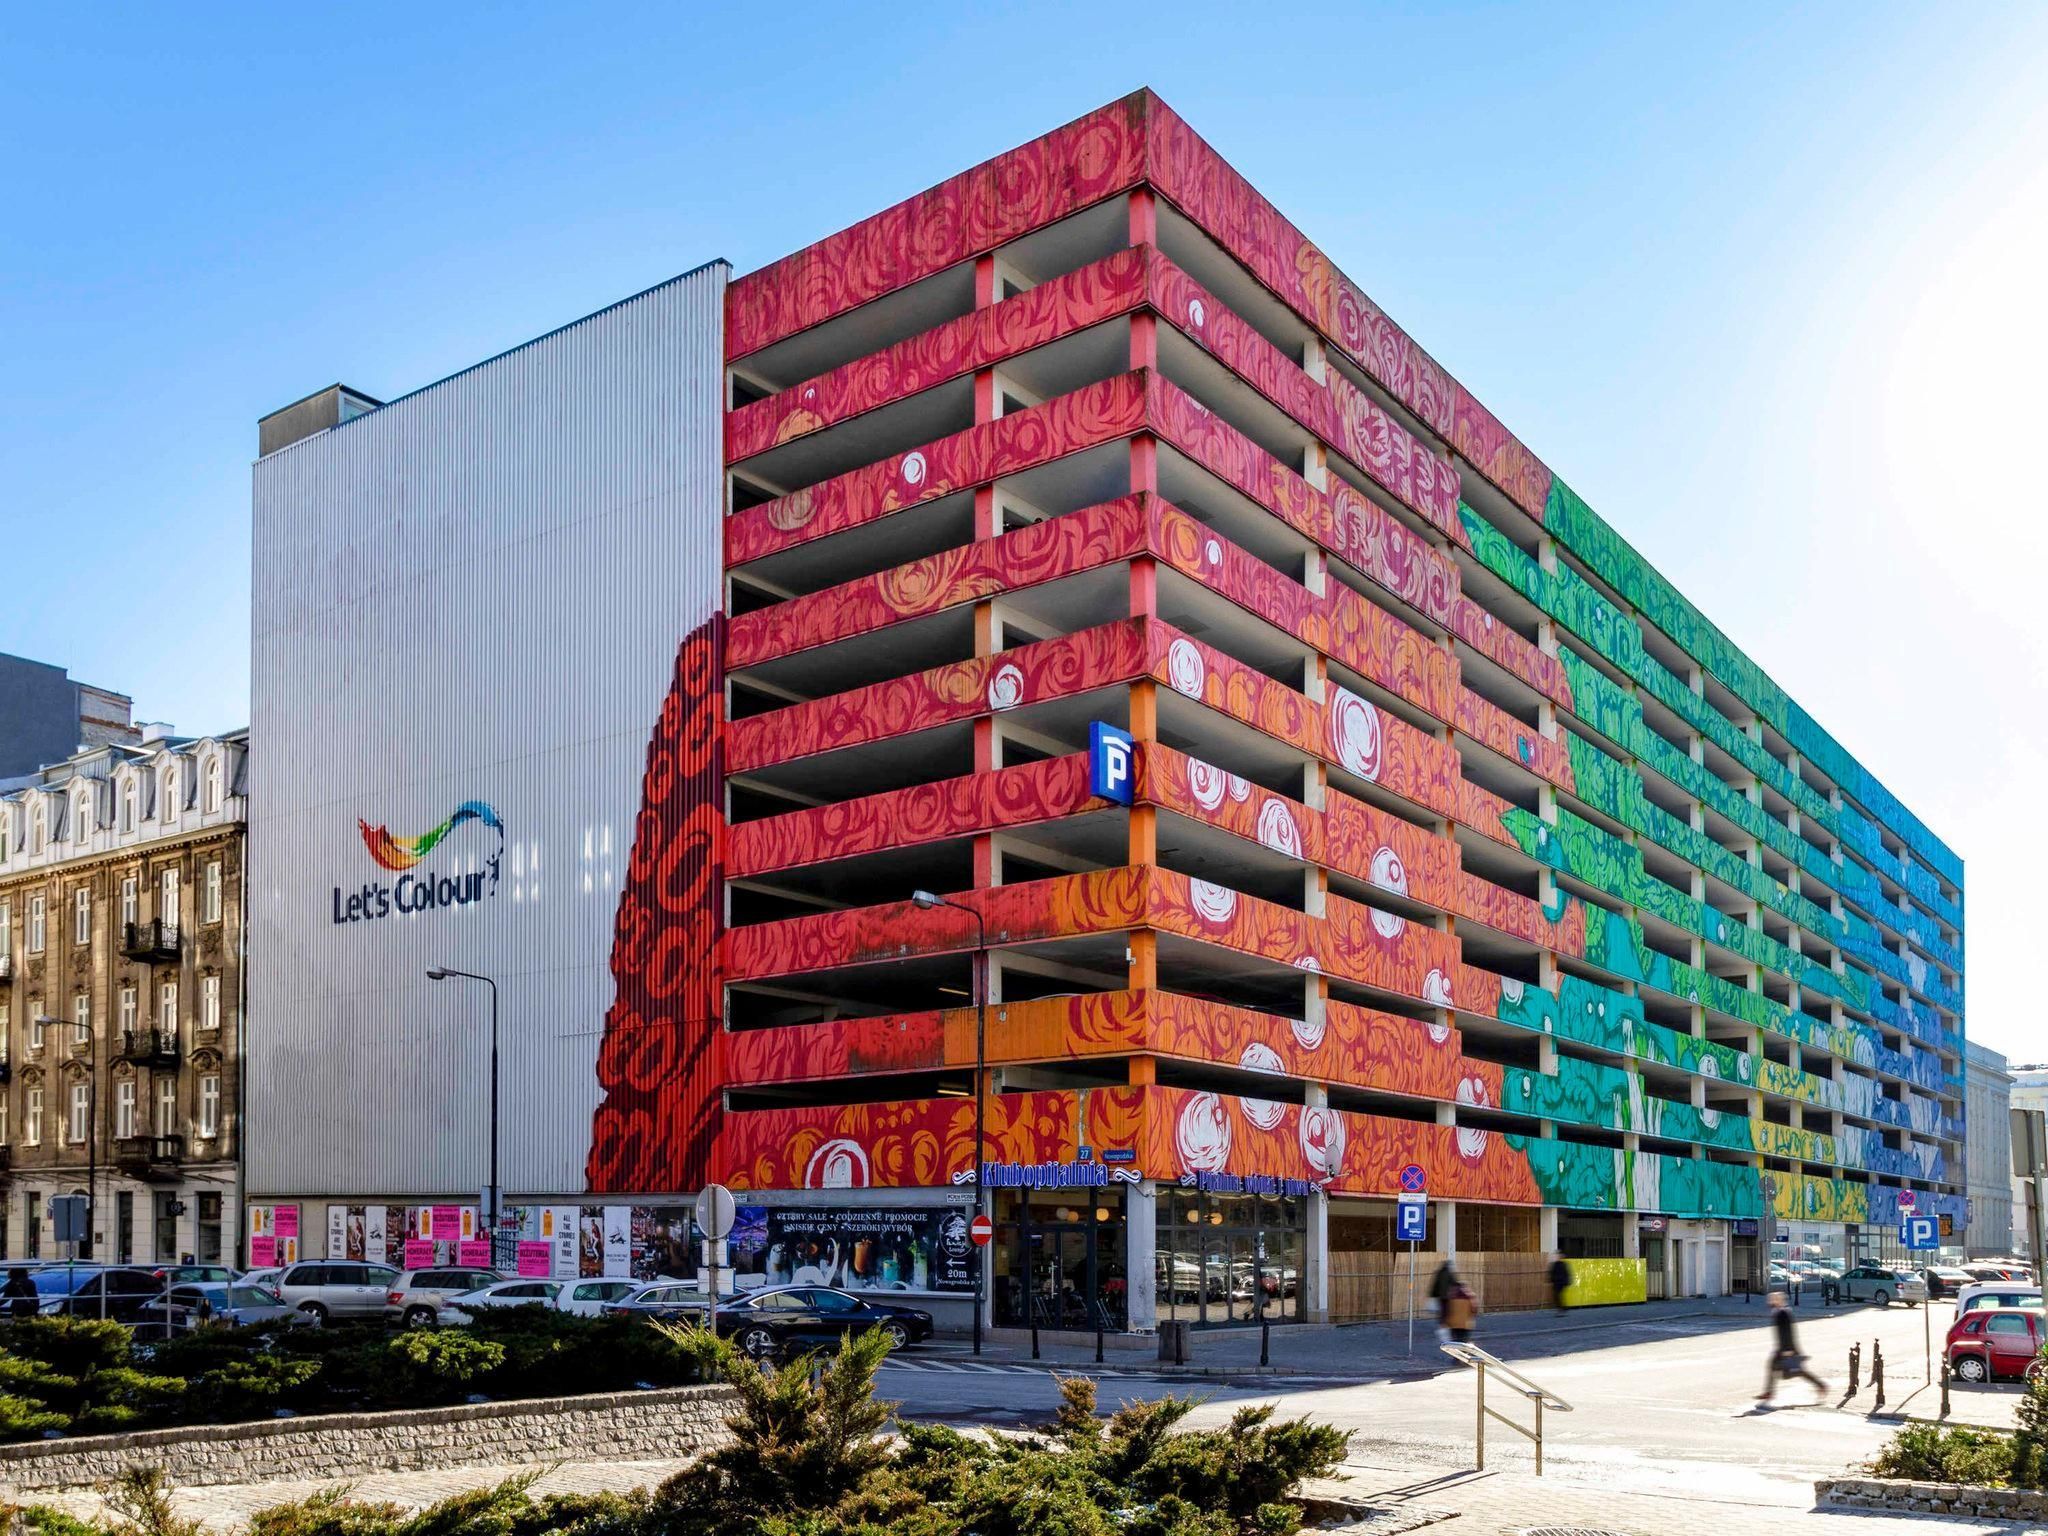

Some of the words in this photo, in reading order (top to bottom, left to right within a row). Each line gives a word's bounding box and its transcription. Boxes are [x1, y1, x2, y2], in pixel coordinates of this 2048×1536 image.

[1108, 745, 1127, 790] P
[333, 882, 390, 924] Let's
[394, 868, 485, 914] Colour
[1080, 1150, 1088, 1159] 27
[982, 1161, 1108, 1189] Klubopijalnia
[837, 1213, 882, 1221] CODZIENNE
[885, 1213, 928, 1221] PROMOCJE
[1404, 1206, 1420, 1229] P
[558, 1231, 575, 1240] STORIES
[790, 1223, 815, 1231] NISKIE
[817, 1223, 838, 1231] CENY
[847, 1224, 881, 1232] SZEROKI
[882, 1223, 913, 1232] WYBÓR
[1913, 1220, 1931, 1246] P
[947, 1269, 968, 1278] 20m
